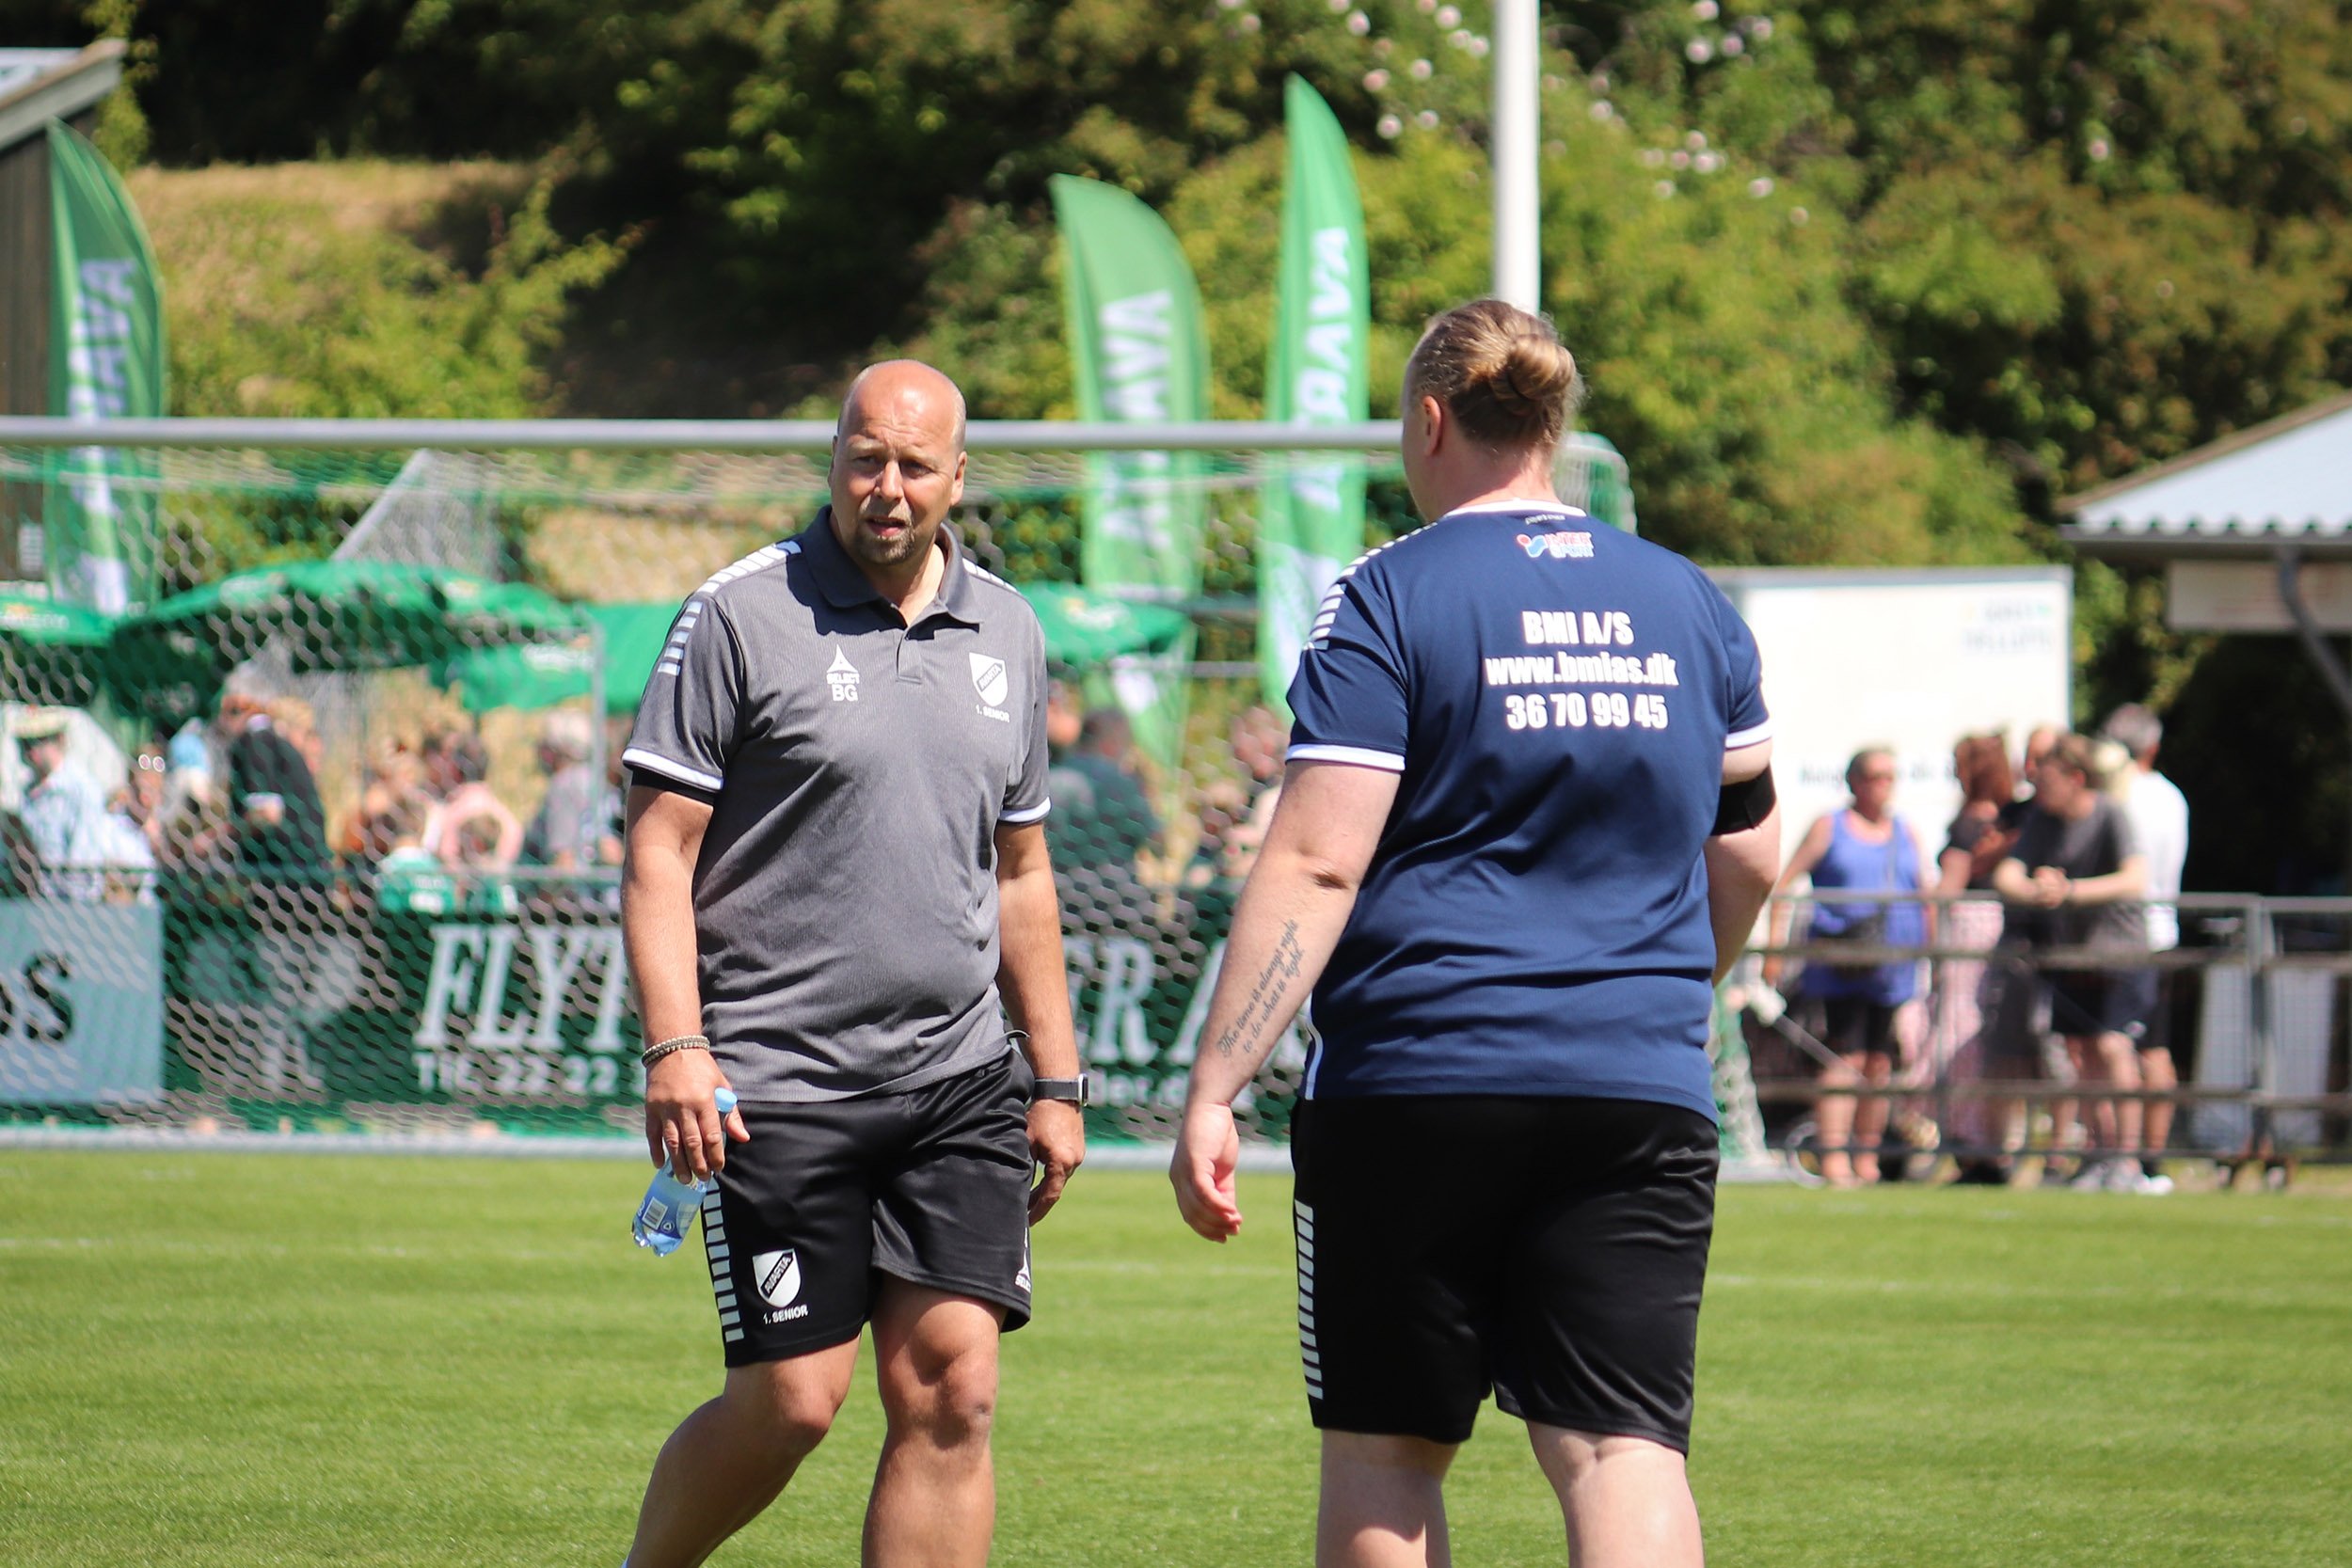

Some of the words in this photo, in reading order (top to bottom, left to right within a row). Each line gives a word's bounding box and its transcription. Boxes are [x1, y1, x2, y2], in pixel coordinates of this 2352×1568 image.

[1521, 610, 1581, 645] BMI
[1582, 611, 1635, 646] A/S
[1485, 651, 1679, 686] www.bmias.dk
[832, 684, 859, 702] BG
[1505, 693, 1548, 730] 36
[1549, 692, 1588, 727] 70
[1591, 692, 1630, 727] 99
[1633, 693, 1669, 729] 45
[983, 705, 1010, 723] SENIOR
[1216, 1026, 1239, 1057] The
[1236, 1002, 1256, 1030] time
[1253, 989, 1263, 1004] is
[1259, 949, 1285, 991] always
[1280, 919, 1299, 949] right
[1243, 1040, 1254, 1053] to
[1251, 1020, 1263, 1039] do
[1262, 990, 1281, 1022] what
[1279, 980, 1287, 994] is
[562, 1053, 619, 1096] 22
[763, 1312, 772, 1324] 1.
[772, 1304, 809, 1323] SENIOR
